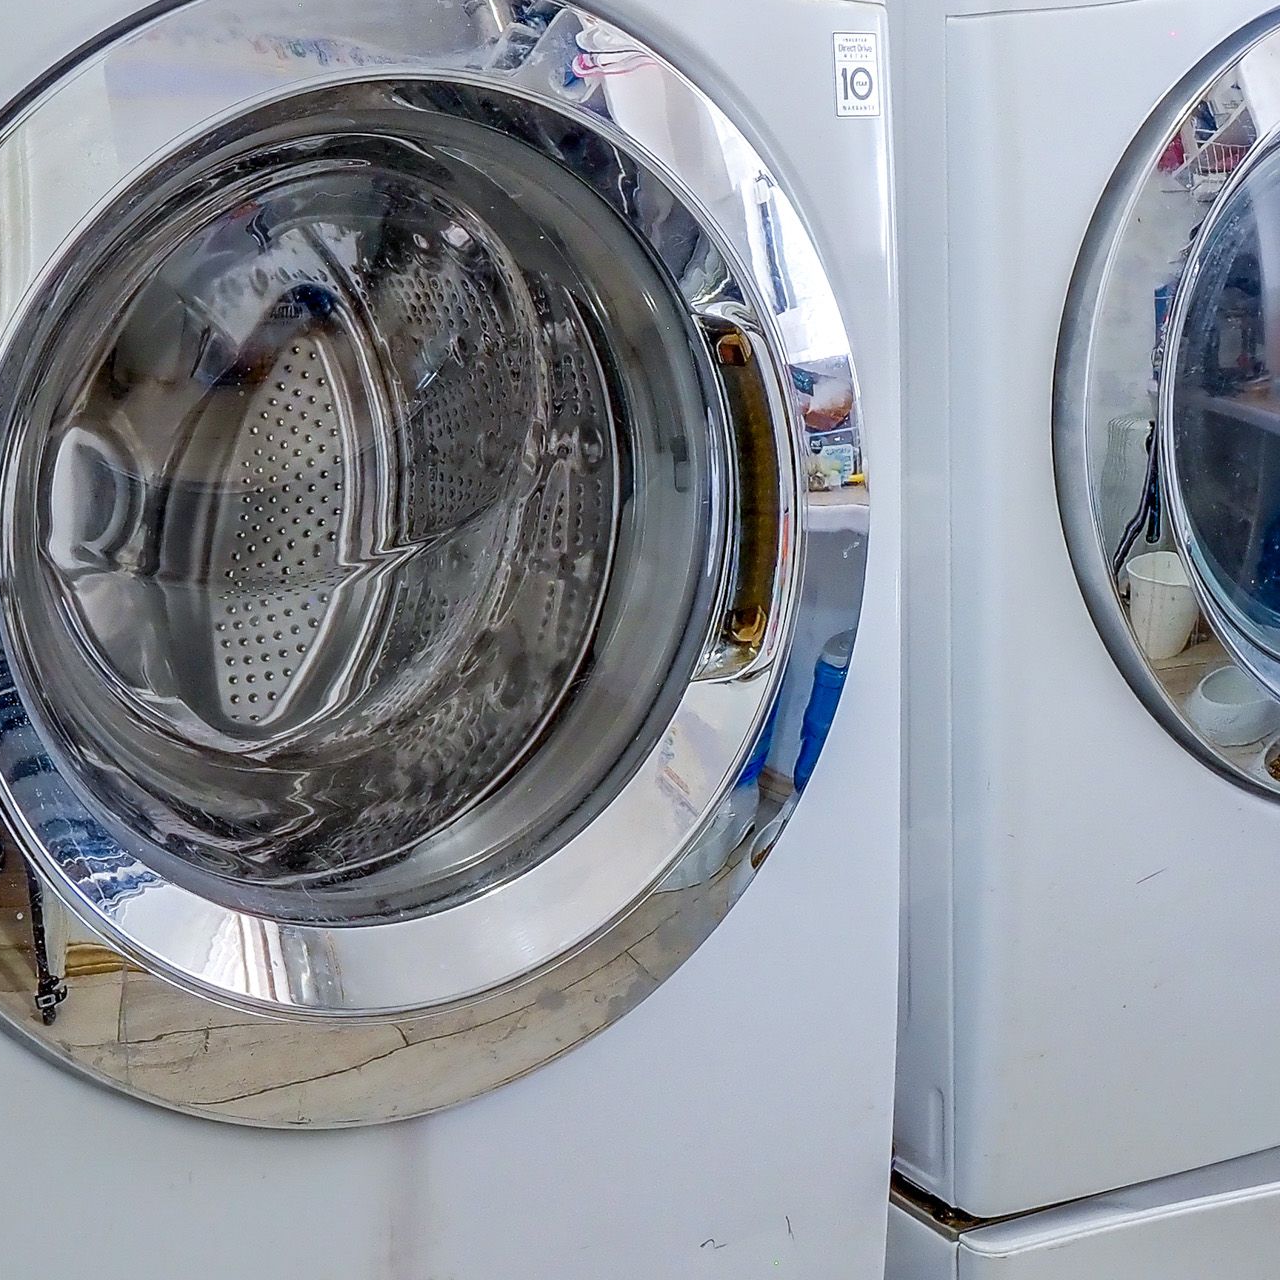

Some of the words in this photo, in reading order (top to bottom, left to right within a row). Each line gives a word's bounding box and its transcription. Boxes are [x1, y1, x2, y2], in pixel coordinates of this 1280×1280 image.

[838, 44, 857, 52] Direct
[857, 44, 872, 53] Drive
[841, 67, 873, 101] 10
